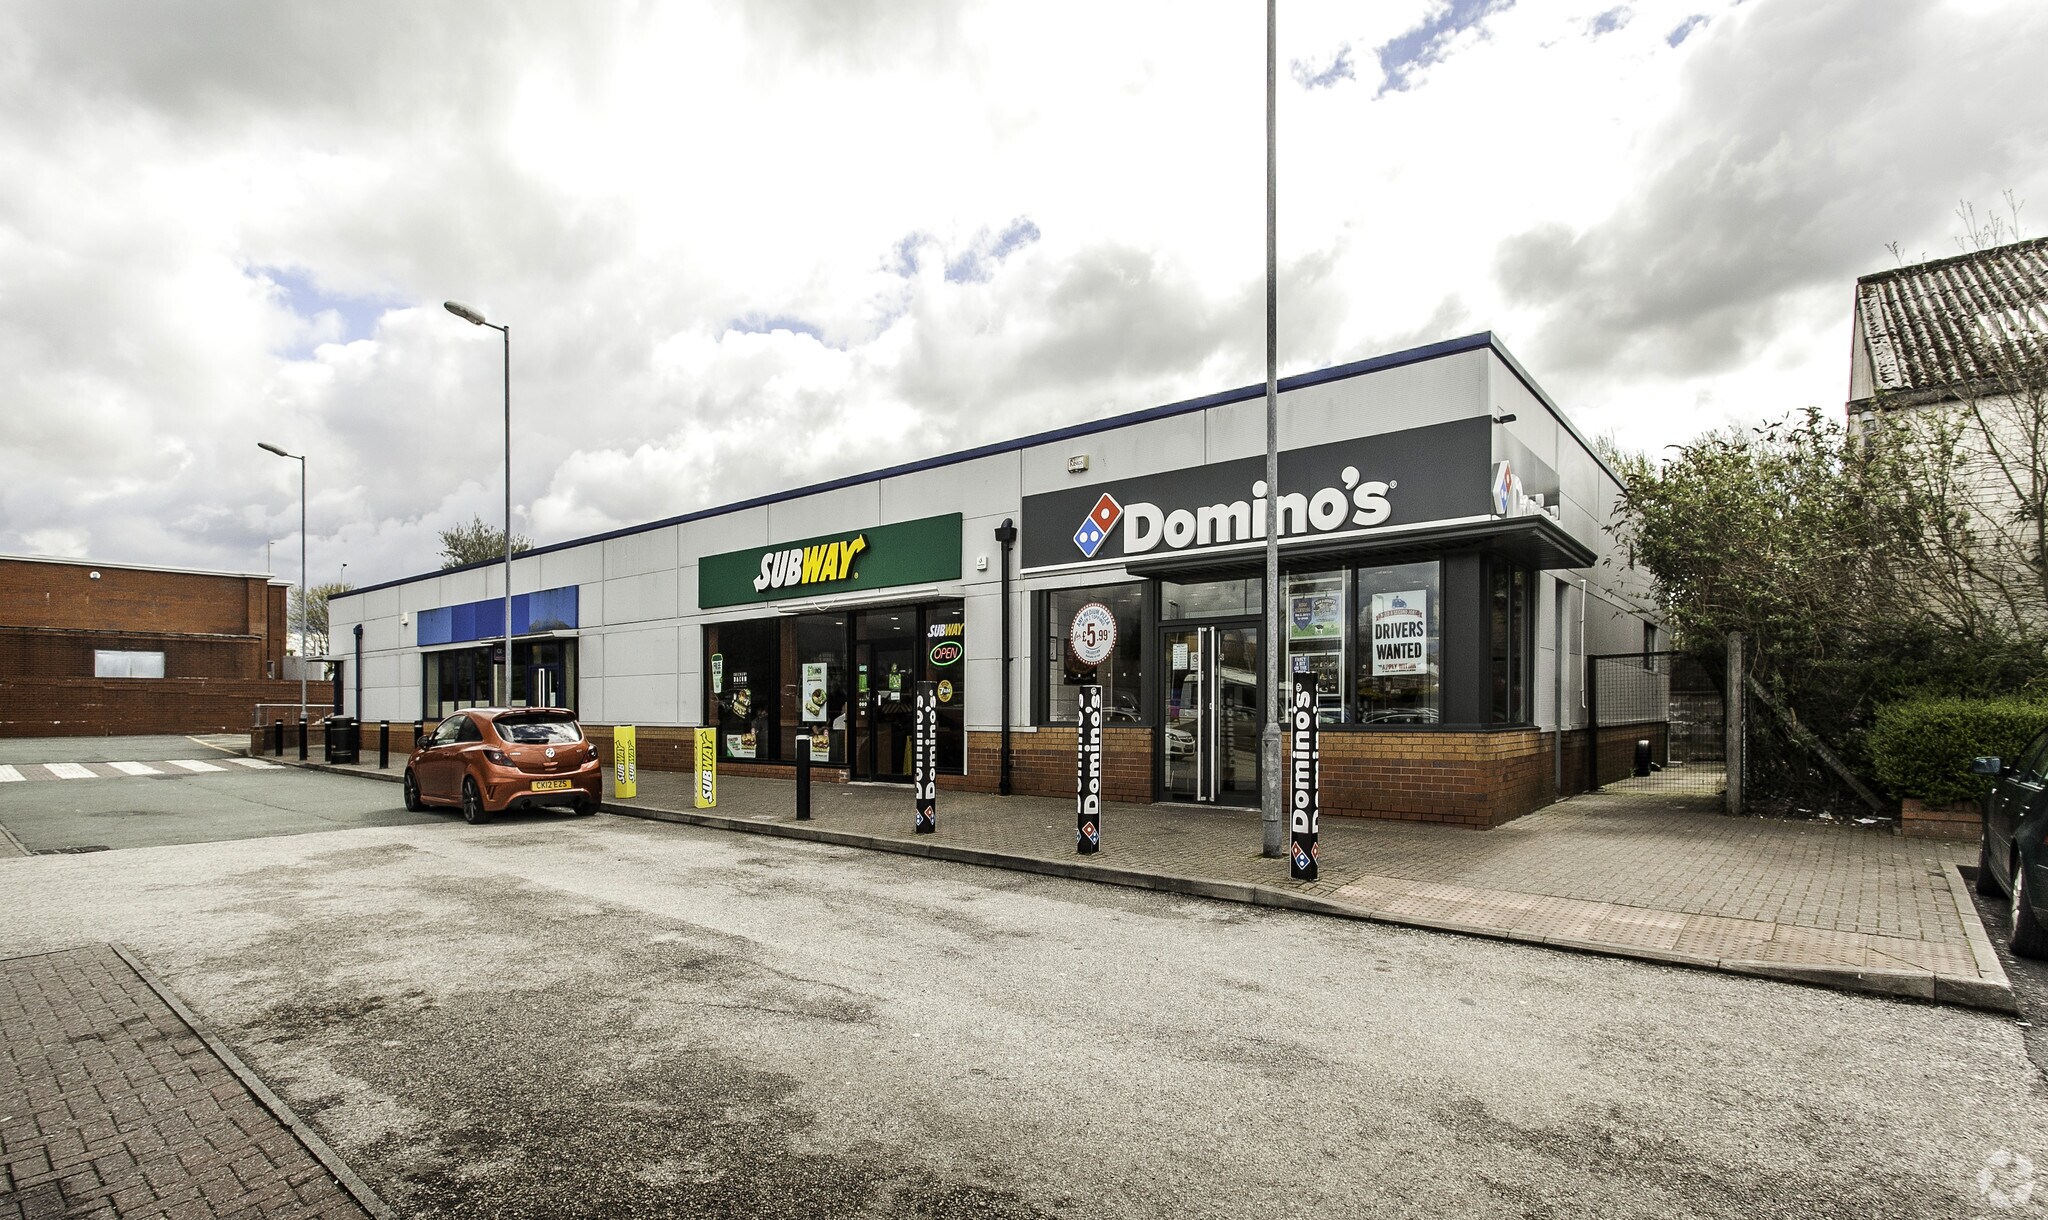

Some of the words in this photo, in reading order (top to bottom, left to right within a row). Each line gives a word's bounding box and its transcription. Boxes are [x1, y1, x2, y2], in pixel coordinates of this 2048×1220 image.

[1123, 466, 1393, 554] Domino's
[753, 533, 867, 592] SUBWAY
[927, 623, 964, 638] SUBWAY
[1375, 621, 1424, 639] DRIVERS
[1376, 642, 1422, 660] WANTED
[934, 647, 958, 659] OPEN
[615, 740, 626, 784] SUBWAY
[628, 740, 636, 783] SUBWAY
[700, 731, 714, 804] SUBWAY
[1084, 694, 1100, 814] Domino's
[1292, 691, 1310, 834] Domino's
